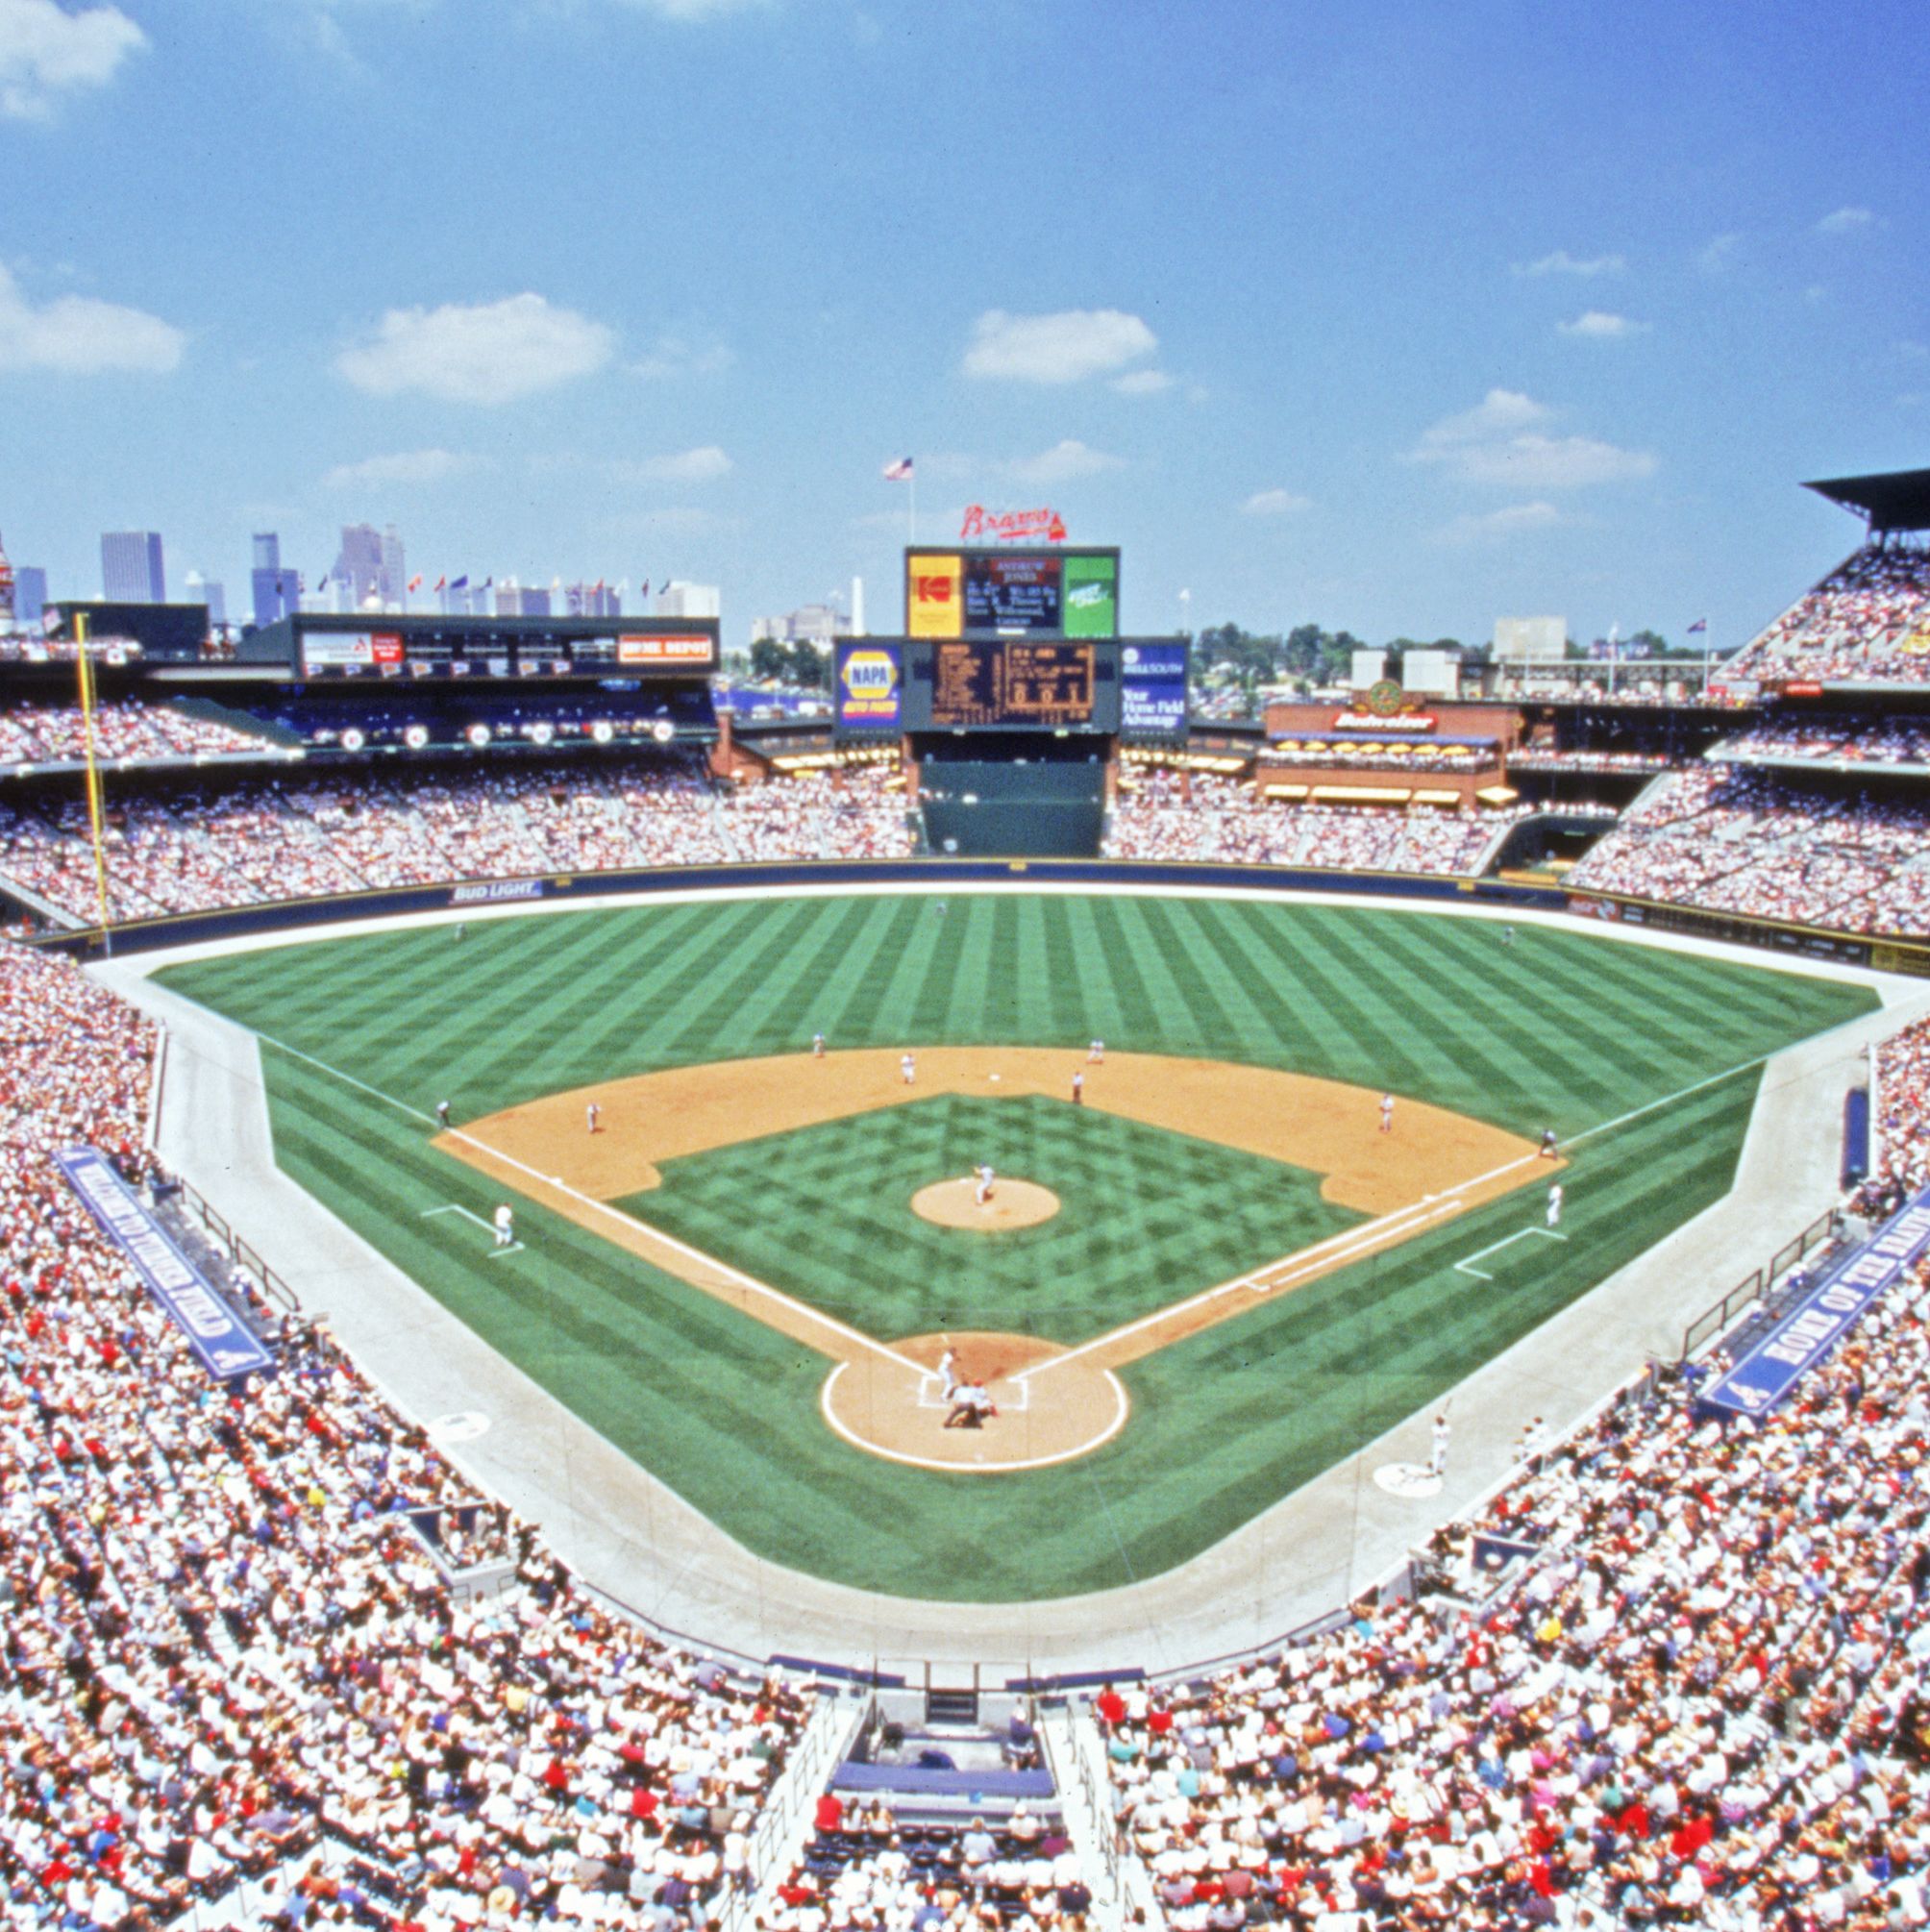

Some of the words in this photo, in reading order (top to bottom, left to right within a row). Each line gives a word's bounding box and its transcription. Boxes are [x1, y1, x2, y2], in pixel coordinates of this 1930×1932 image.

[960, 505, 1050, 538] Braves
[623, 641, 661, 654] HOME
[666, 641, 708, 654] DEPOT
[853, 665, 888, 685] NAPA
[1122, 688, 1149, 702] Your
[1123, 701, 1155, 713] Home
[1157, 700, 1184, 714] Field
[1122, 713, 1177, 729] Advantage
[1335, 712, 1433, 729] Budweiser
[454, 886, 488, 901] BUD
[489, 880, 535, 898] LIGHT
[1840, 1252, 1899, 1287] THE
[1819, 1283, 1866, 1311] OF
[167, 1284, 234, 1337] FIELD
[1763, 1308, 1842, 1365] HOME
